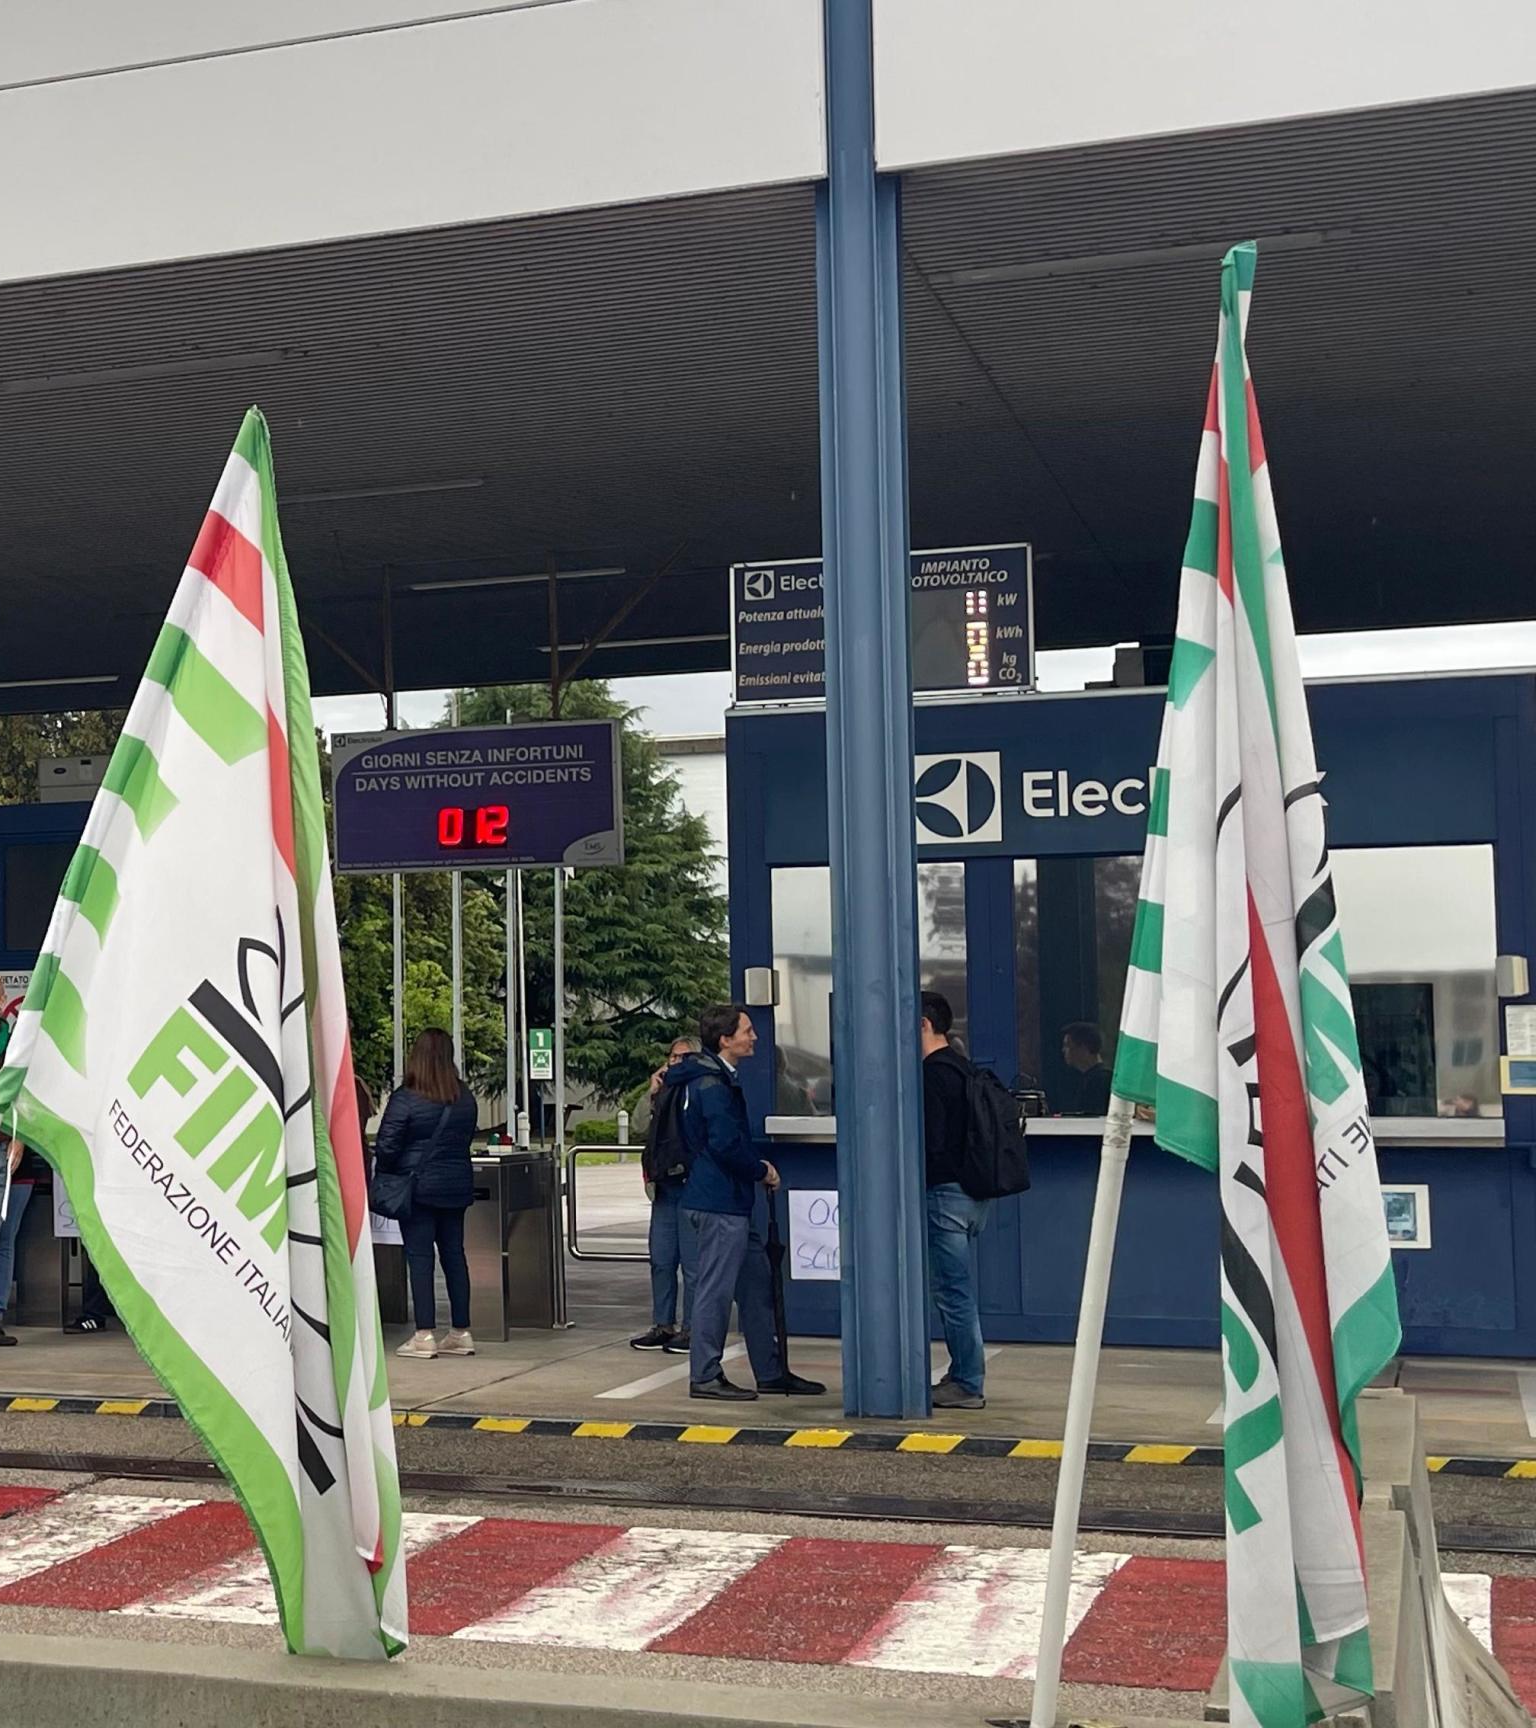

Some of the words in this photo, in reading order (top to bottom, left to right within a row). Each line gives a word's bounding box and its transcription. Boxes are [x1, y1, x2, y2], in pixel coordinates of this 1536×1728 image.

[920, 558, 990, 574] IMPIANTO
[996, 593, 1018, 607] kW
[738, 611, 784, 623] Potenza
[995, 625, 1023, 640] kWh
[738, 641, 781, 656] Energia
[1002, 651, 1017, 667] kg
[738, 671, 791, 686] Emissioni
[361, 752, 421, 770] GIORNI
[425, 749, 483, 766] SENZA
[488, 744, 584, 763] INFORTUNI
[355, 776, 401, 792] DAYS
[405, 771, 483, 790] WITHOUT
[489, 767, 592, 785] ACCIDENTS
[535, 1031, 545, 1047] 1
[126, 1005, 288, 1254] FIM
[107, 1097, 241, 1265] FEDERAZIONE
